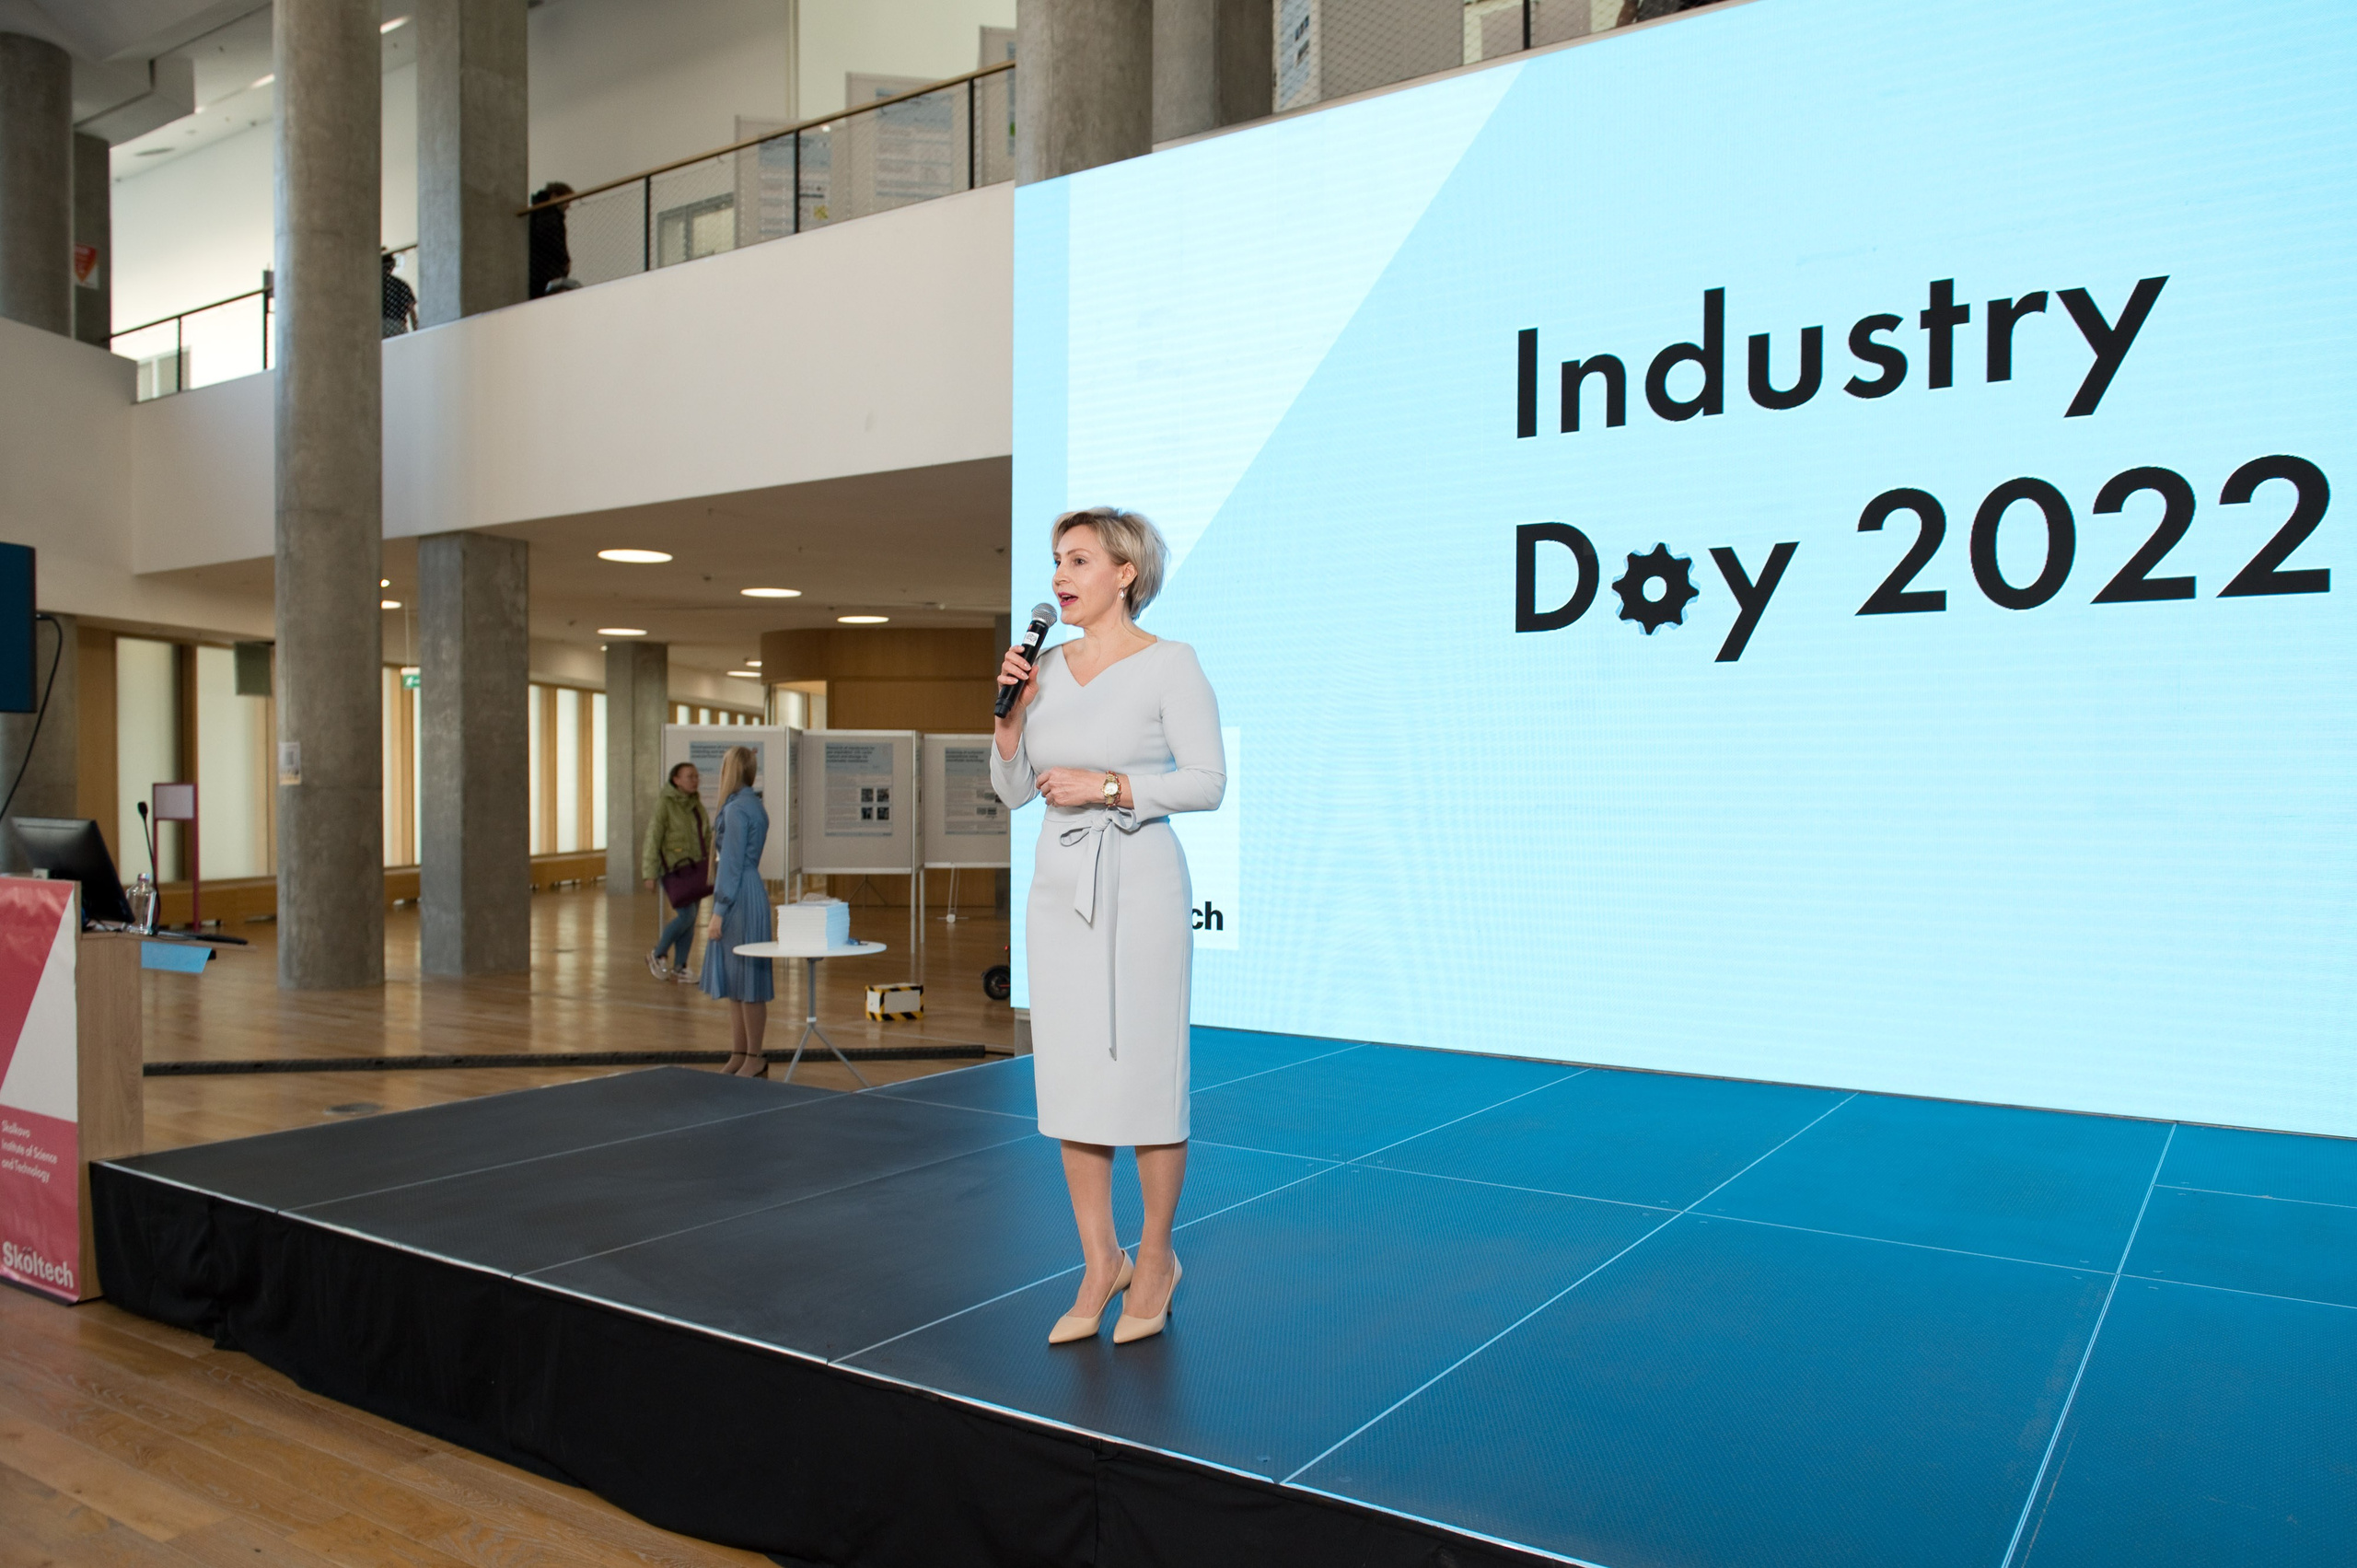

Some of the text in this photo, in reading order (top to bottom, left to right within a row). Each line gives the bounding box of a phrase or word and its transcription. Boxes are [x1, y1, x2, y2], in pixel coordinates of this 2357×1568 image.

[1516, 275, 2170, 439] Industry
[1855, 454, 2330, 616] 2022
[2, 1158, 50, 1184] and Technology
[33, 1147, 57, 1165] Science
